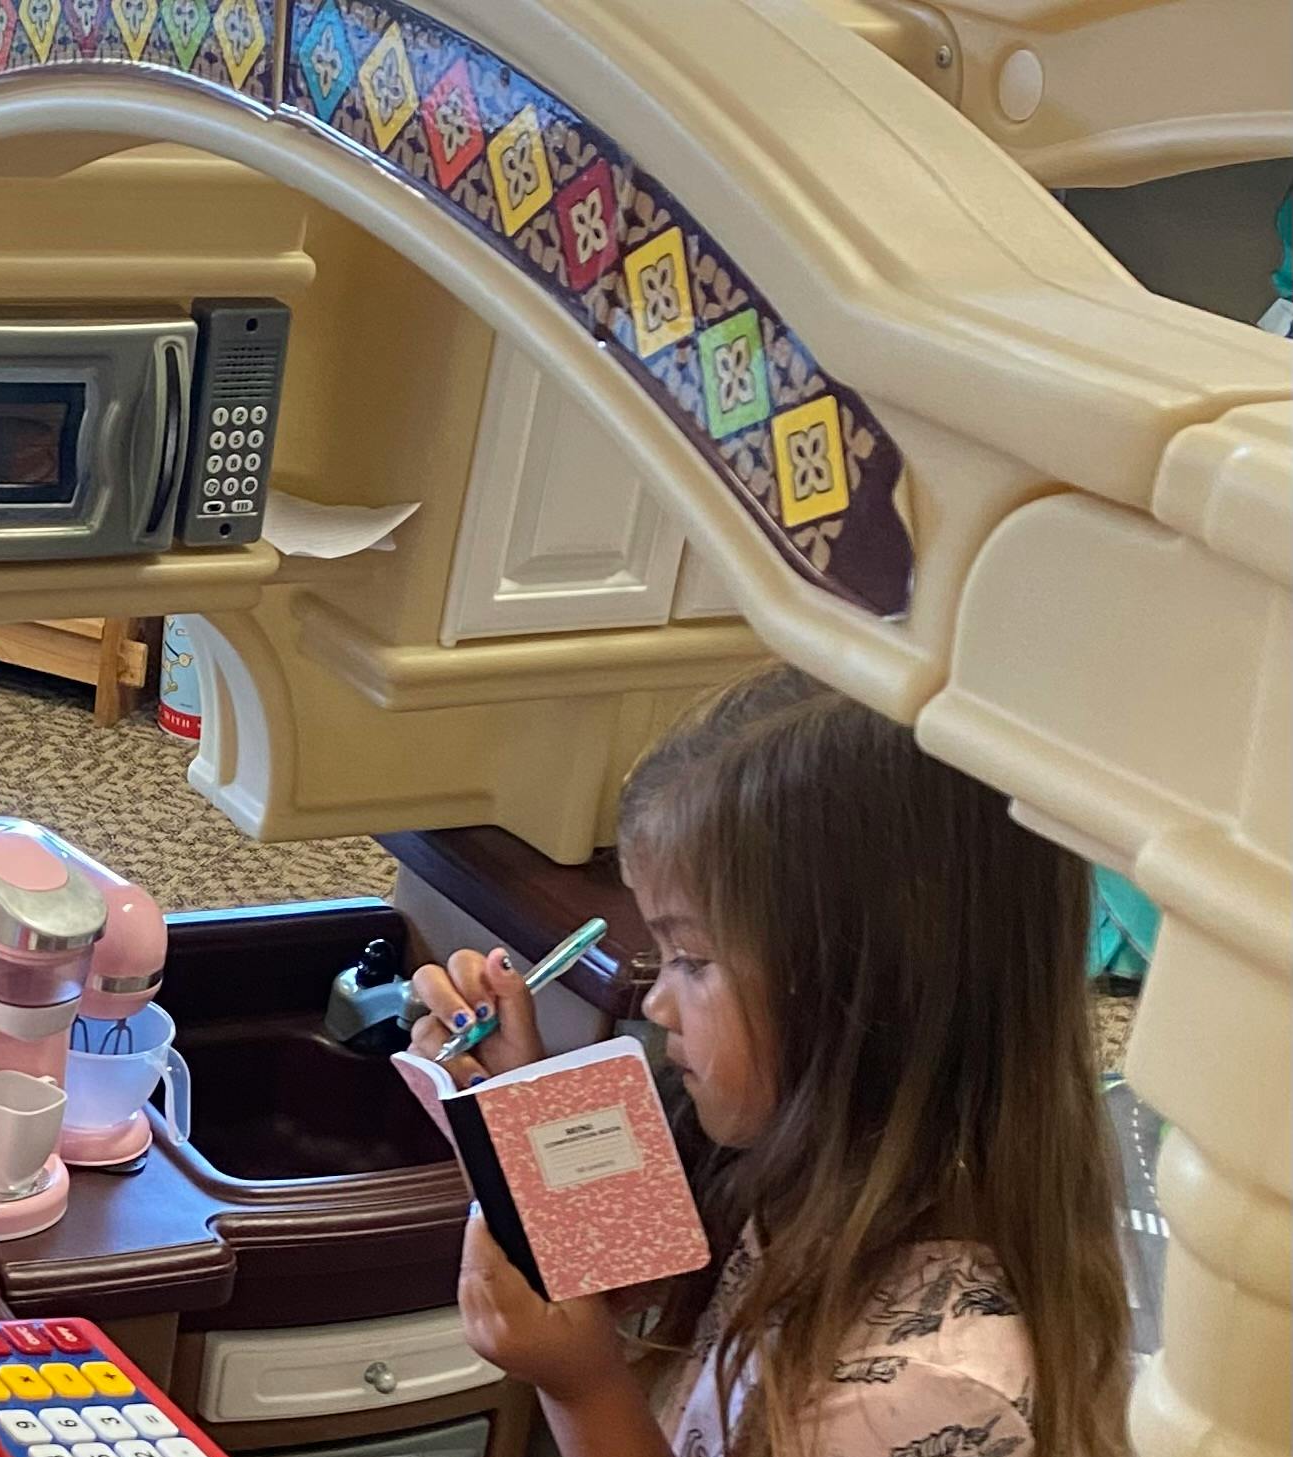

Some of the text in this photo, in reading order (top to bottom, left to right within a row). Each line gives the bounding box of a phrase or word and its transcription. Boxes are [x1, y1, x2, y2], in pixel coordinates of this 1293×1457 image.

[16, 1420, 37, 1429] 9
[57, 1418, 78, 1428] 6
[101, 1416, 120, 1426] 3
